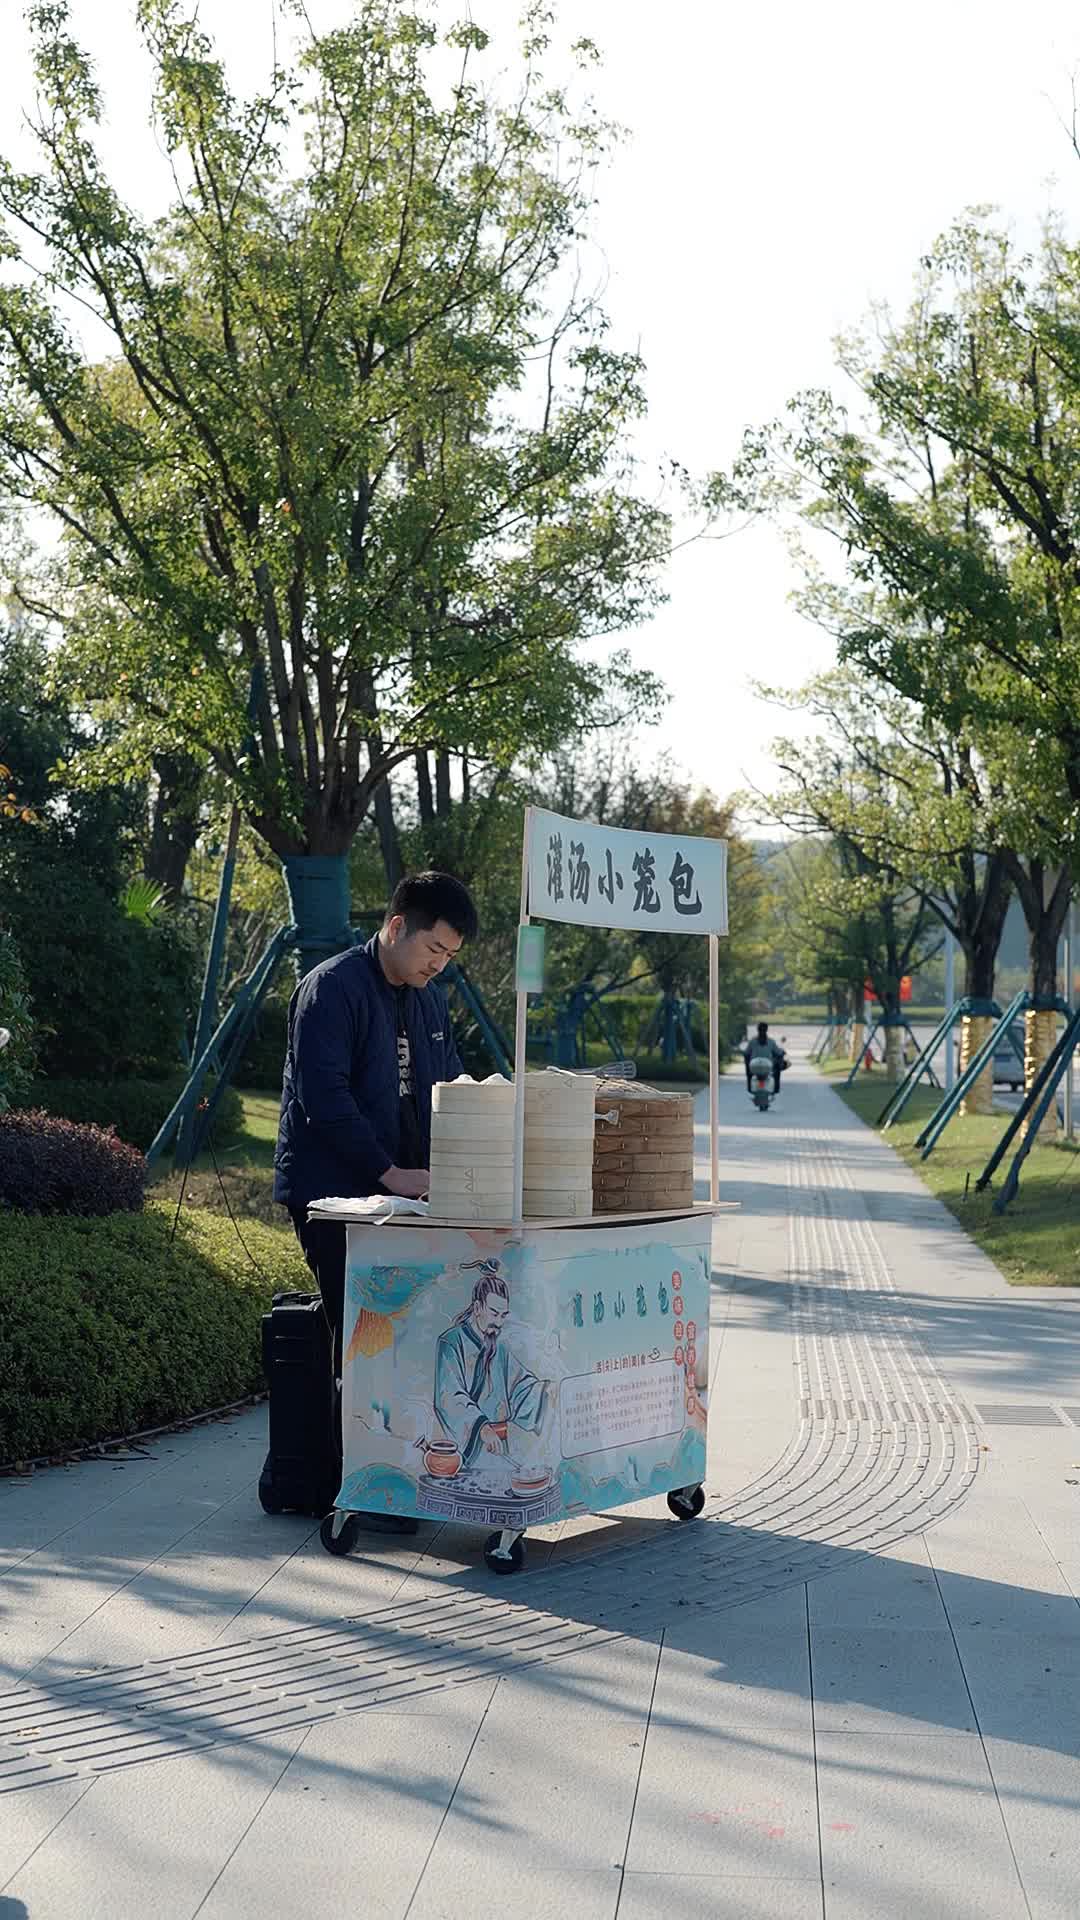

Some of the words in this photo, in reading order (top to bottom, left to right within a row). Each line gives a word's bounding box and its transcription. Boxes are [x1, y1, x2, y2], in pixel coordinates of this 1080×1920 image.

[547, 832, 702, 915] 灌汤小笼包
